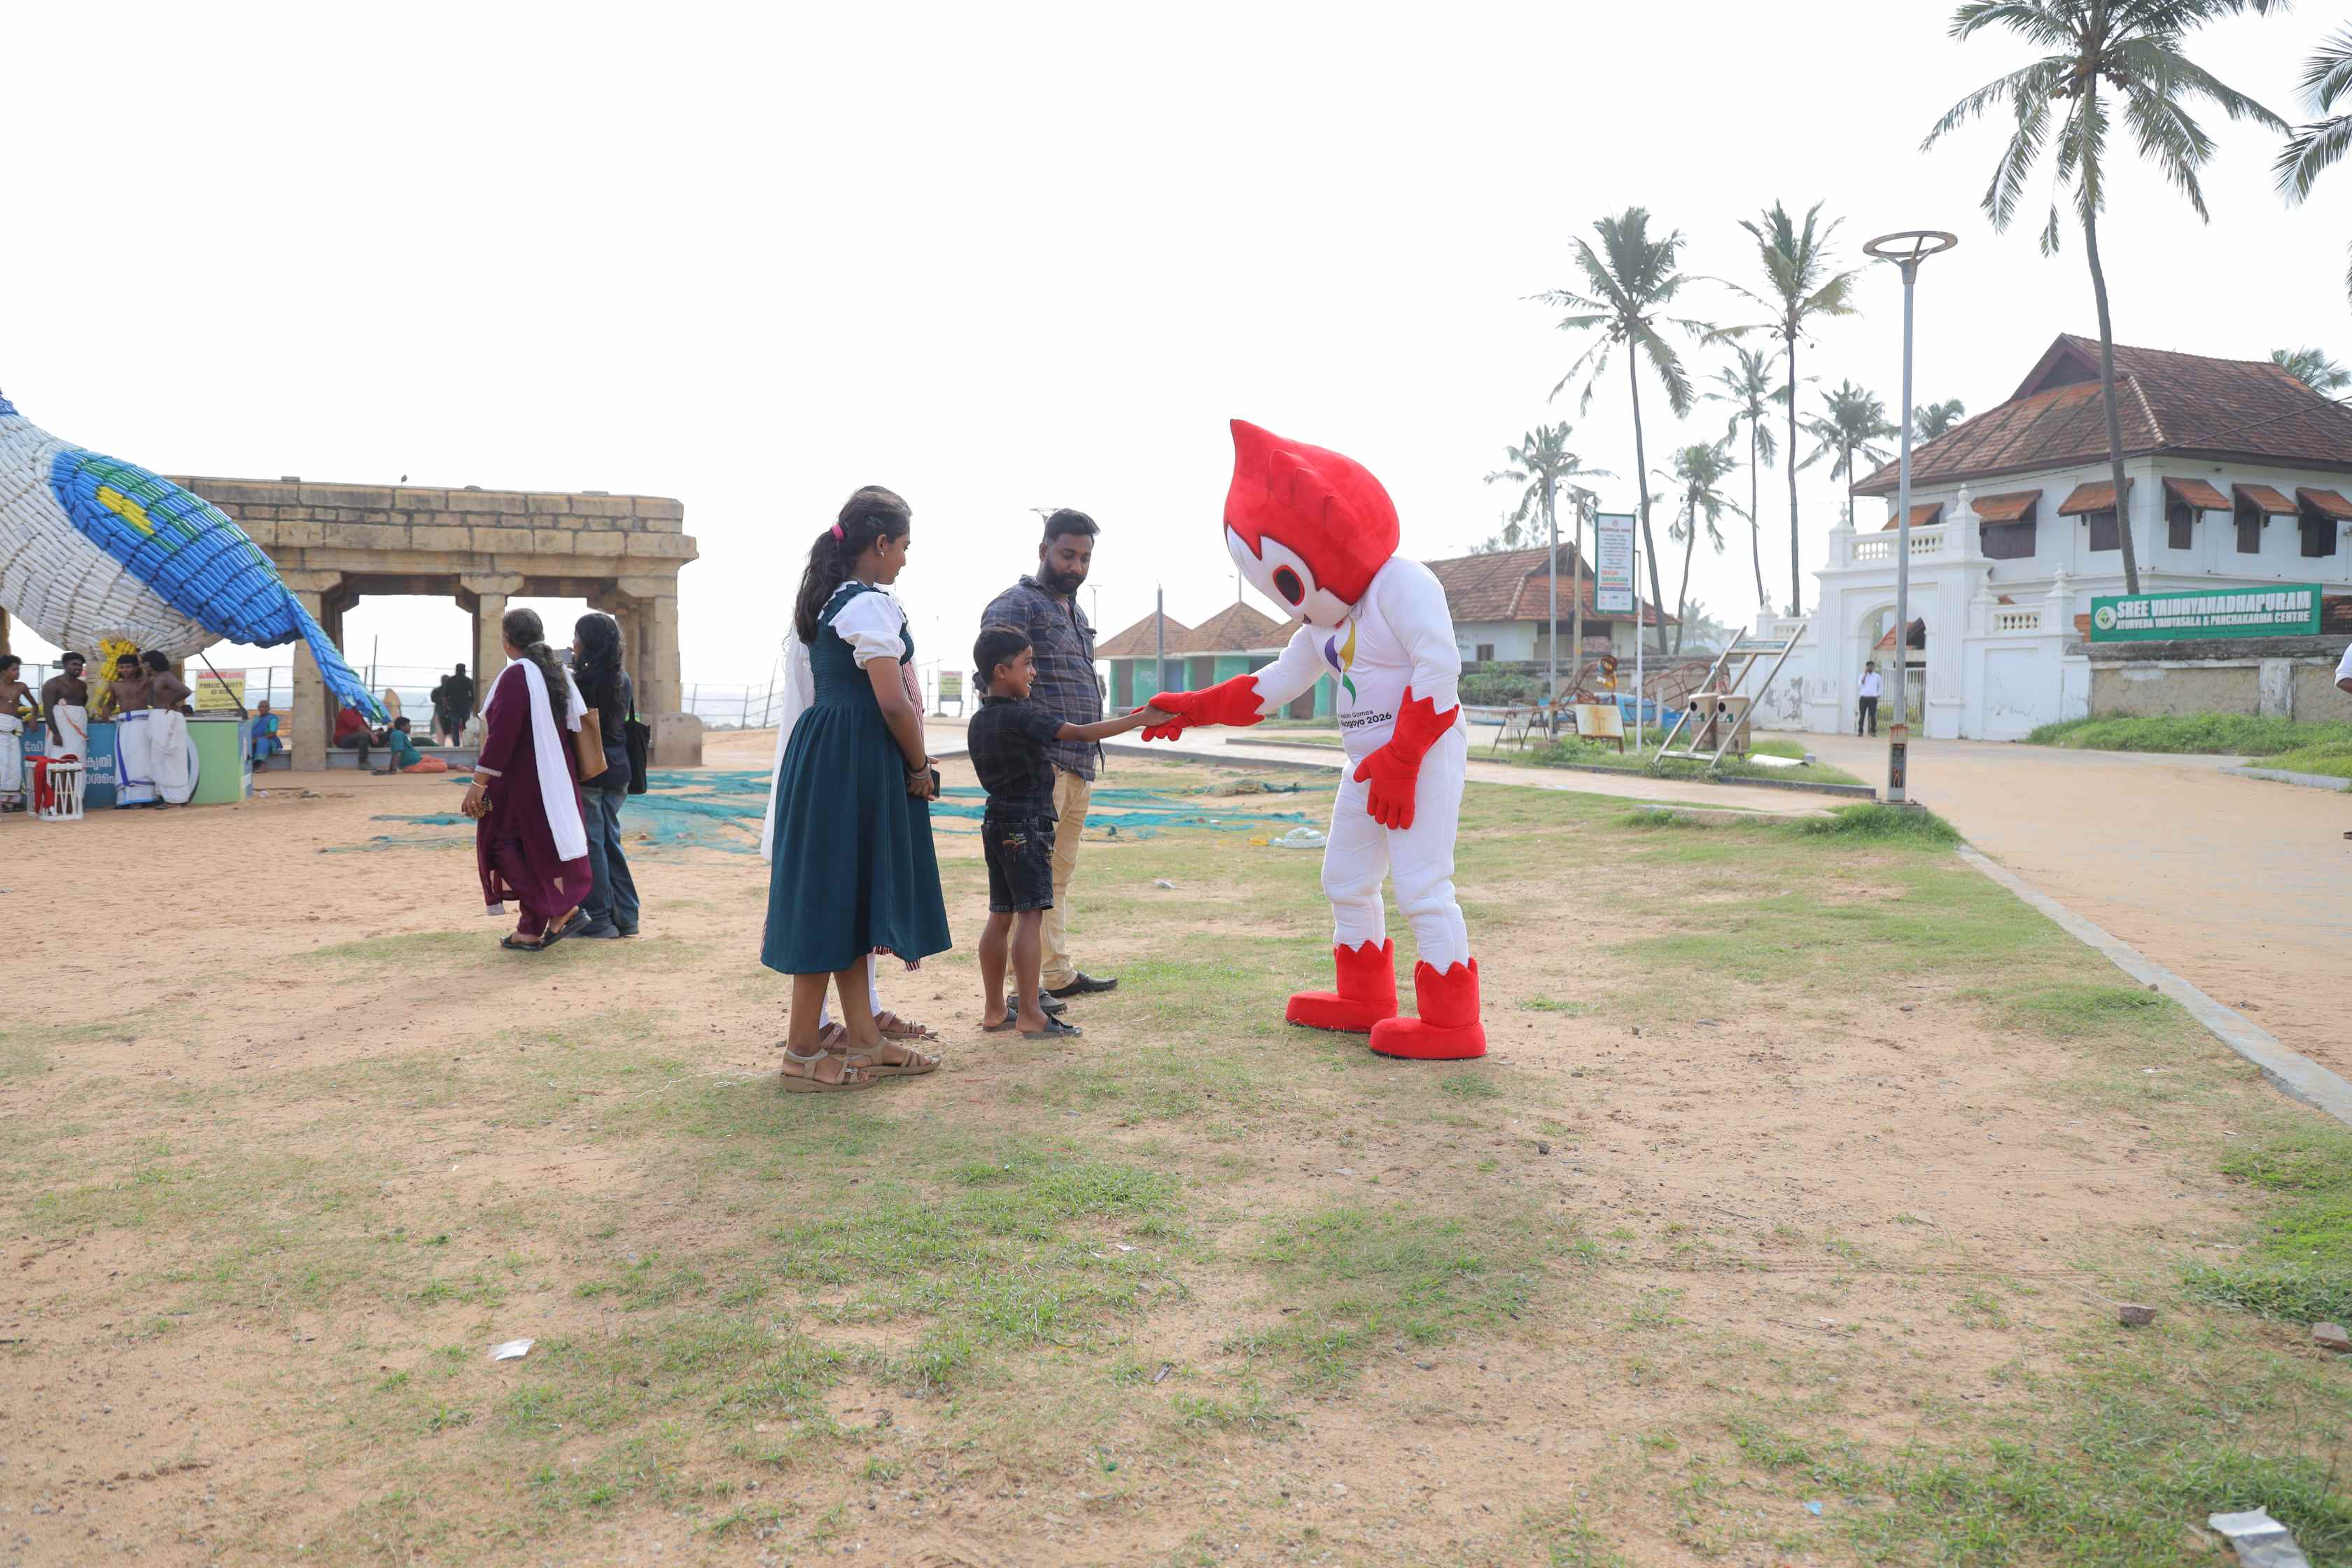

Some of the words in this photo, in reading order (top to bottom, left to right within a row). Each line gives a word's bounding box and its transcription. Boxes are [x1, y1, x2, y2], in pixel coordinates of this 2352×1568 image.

[2117, 600, 2150, 619] SREE
[2150, 591, 2311, 617] VAIDHYANADHAPURAM
[2116, 617, 2154, 630] AYURVEDA
[2155, 615, 2202, 628] VAIDYASALA
[2211, 612, 2274, 626] PANCHAKARMA
[2275, 611, 2311, 623] CENTRE
[1366, 712, 1392, 724] 2026
